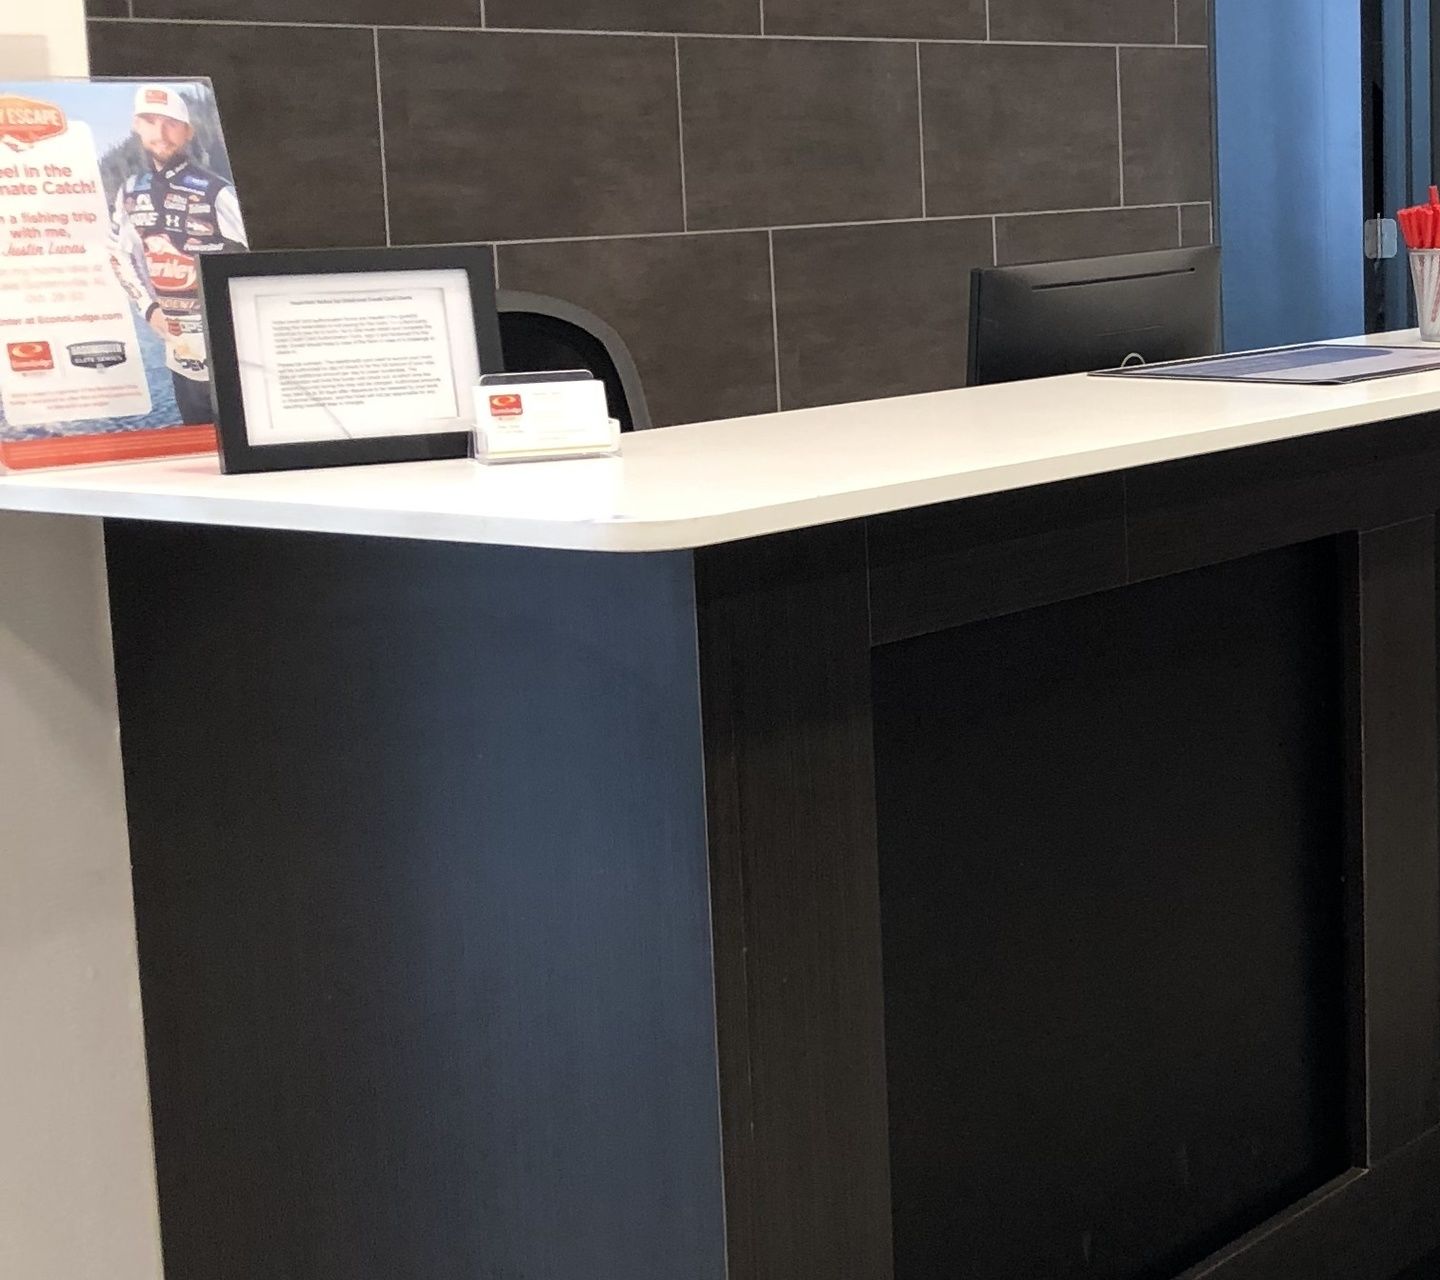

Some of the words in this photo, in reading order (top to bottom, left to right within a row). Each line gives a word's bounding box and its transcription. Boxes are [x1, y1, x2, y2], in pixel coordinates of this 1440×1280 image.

[24, 164, 41, 178] in
[44, 164, 72, 178] the
[43, 180, 97, 195] Catch!
[21, 213, 70, 226] fishing
[72, 211, 97, 224] trip
[10, 227, 42, 239] with
